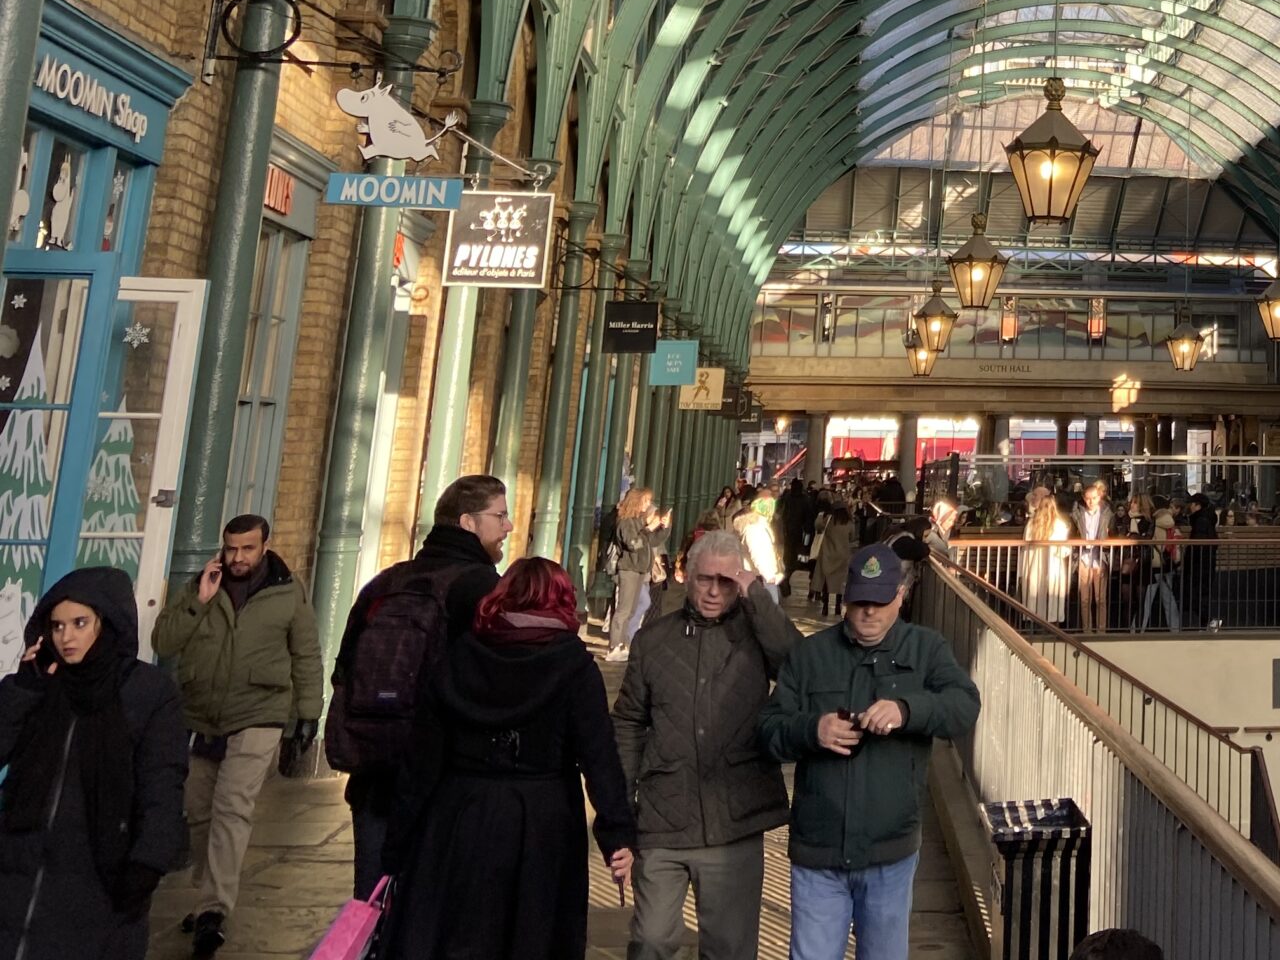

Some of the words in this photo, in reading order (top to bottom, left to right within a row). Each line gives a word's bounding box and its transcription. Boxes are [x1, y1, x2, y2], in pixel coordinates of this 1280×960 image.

[36, 53, 114, 121] MOOMIN
[114, 93, 147, 143] Shop
[340, 176, 448, 205] MOOMIN
[453, 243, 539, 269] PYLONES
[608, 321, 630, 329] Miller
[631, 321, 654, 329] Harris
[979, 365, 1007, 373] SOUTH
[1009, 365, 1033, 373] HALL
